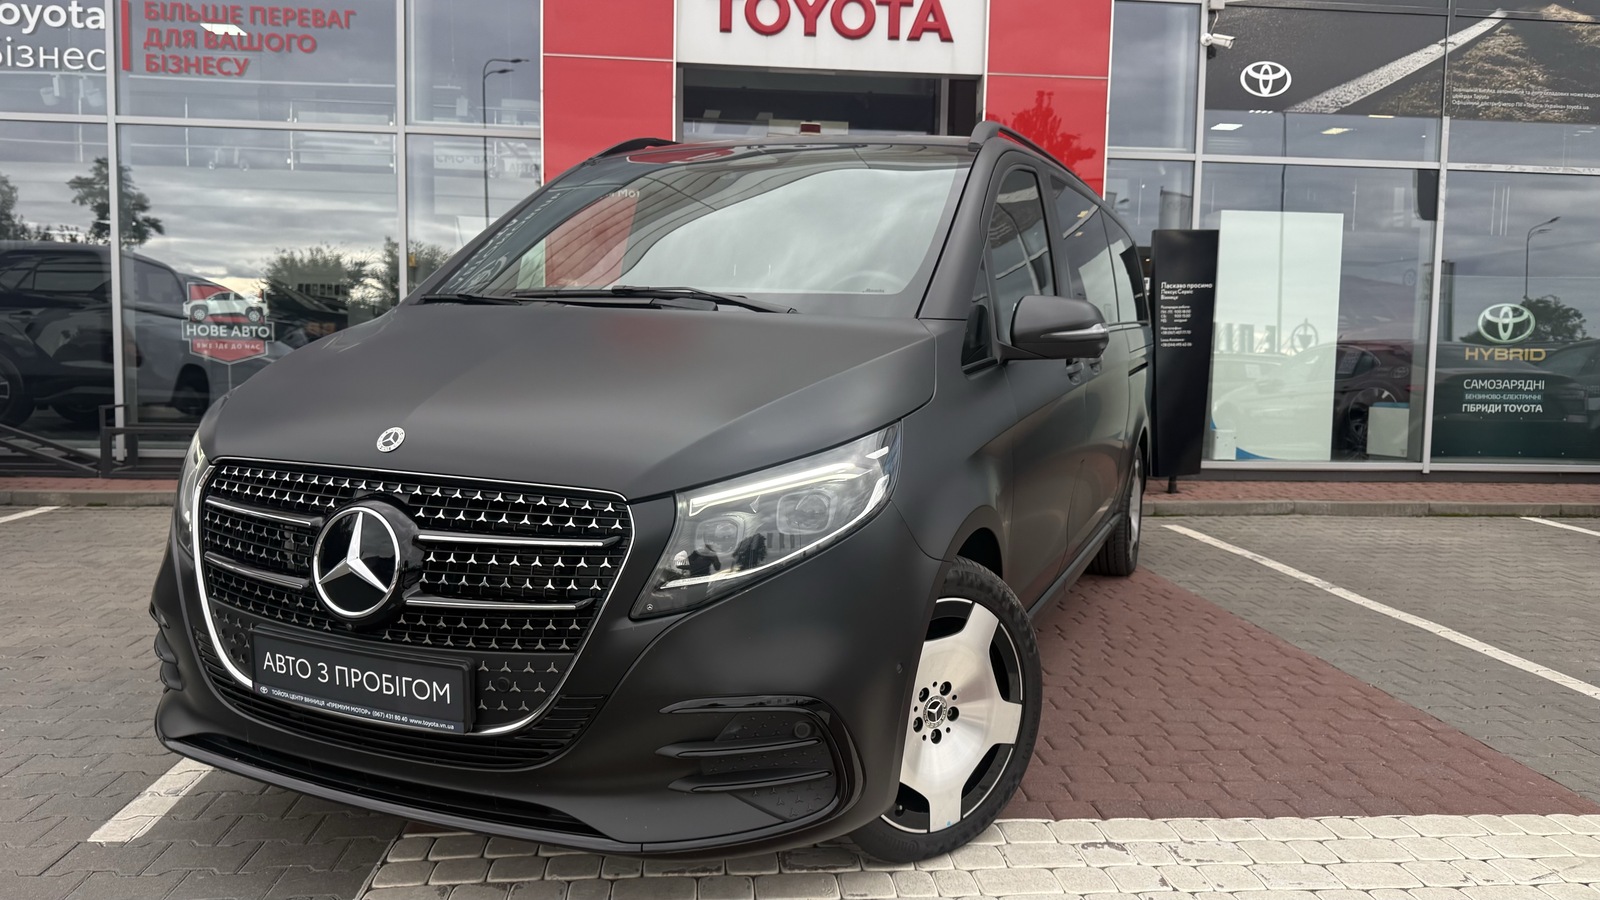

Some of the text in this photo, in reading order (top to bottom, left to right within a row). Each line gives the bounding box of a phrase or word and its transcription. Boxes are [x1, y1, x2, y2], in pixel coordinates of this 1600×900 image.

[144, 1, 357, 30] БІЛЬШЕ ПЕРЕВАГ
[719, 0, 954, 42] TOYOTA
[143, 27, 318, 54] ДЛЯ ВАШОГО
[0, 36, 105, 71] ізнес
[145, 53, 250, 77] БІЗНЕСУ
[186, 324, 270, 338] НОВЕ АВТО
[1464, 347, 1547, 361] HYBRID
[1463, 379, 1546, 391] САМОЗАРЯДНІ
[1462, 404, 1544, 414] ГІБРИДИ TOYOTA
[263, 651, 312, 679] АВТО
[335, 665, 451, 704] ПРОБІГОМ
